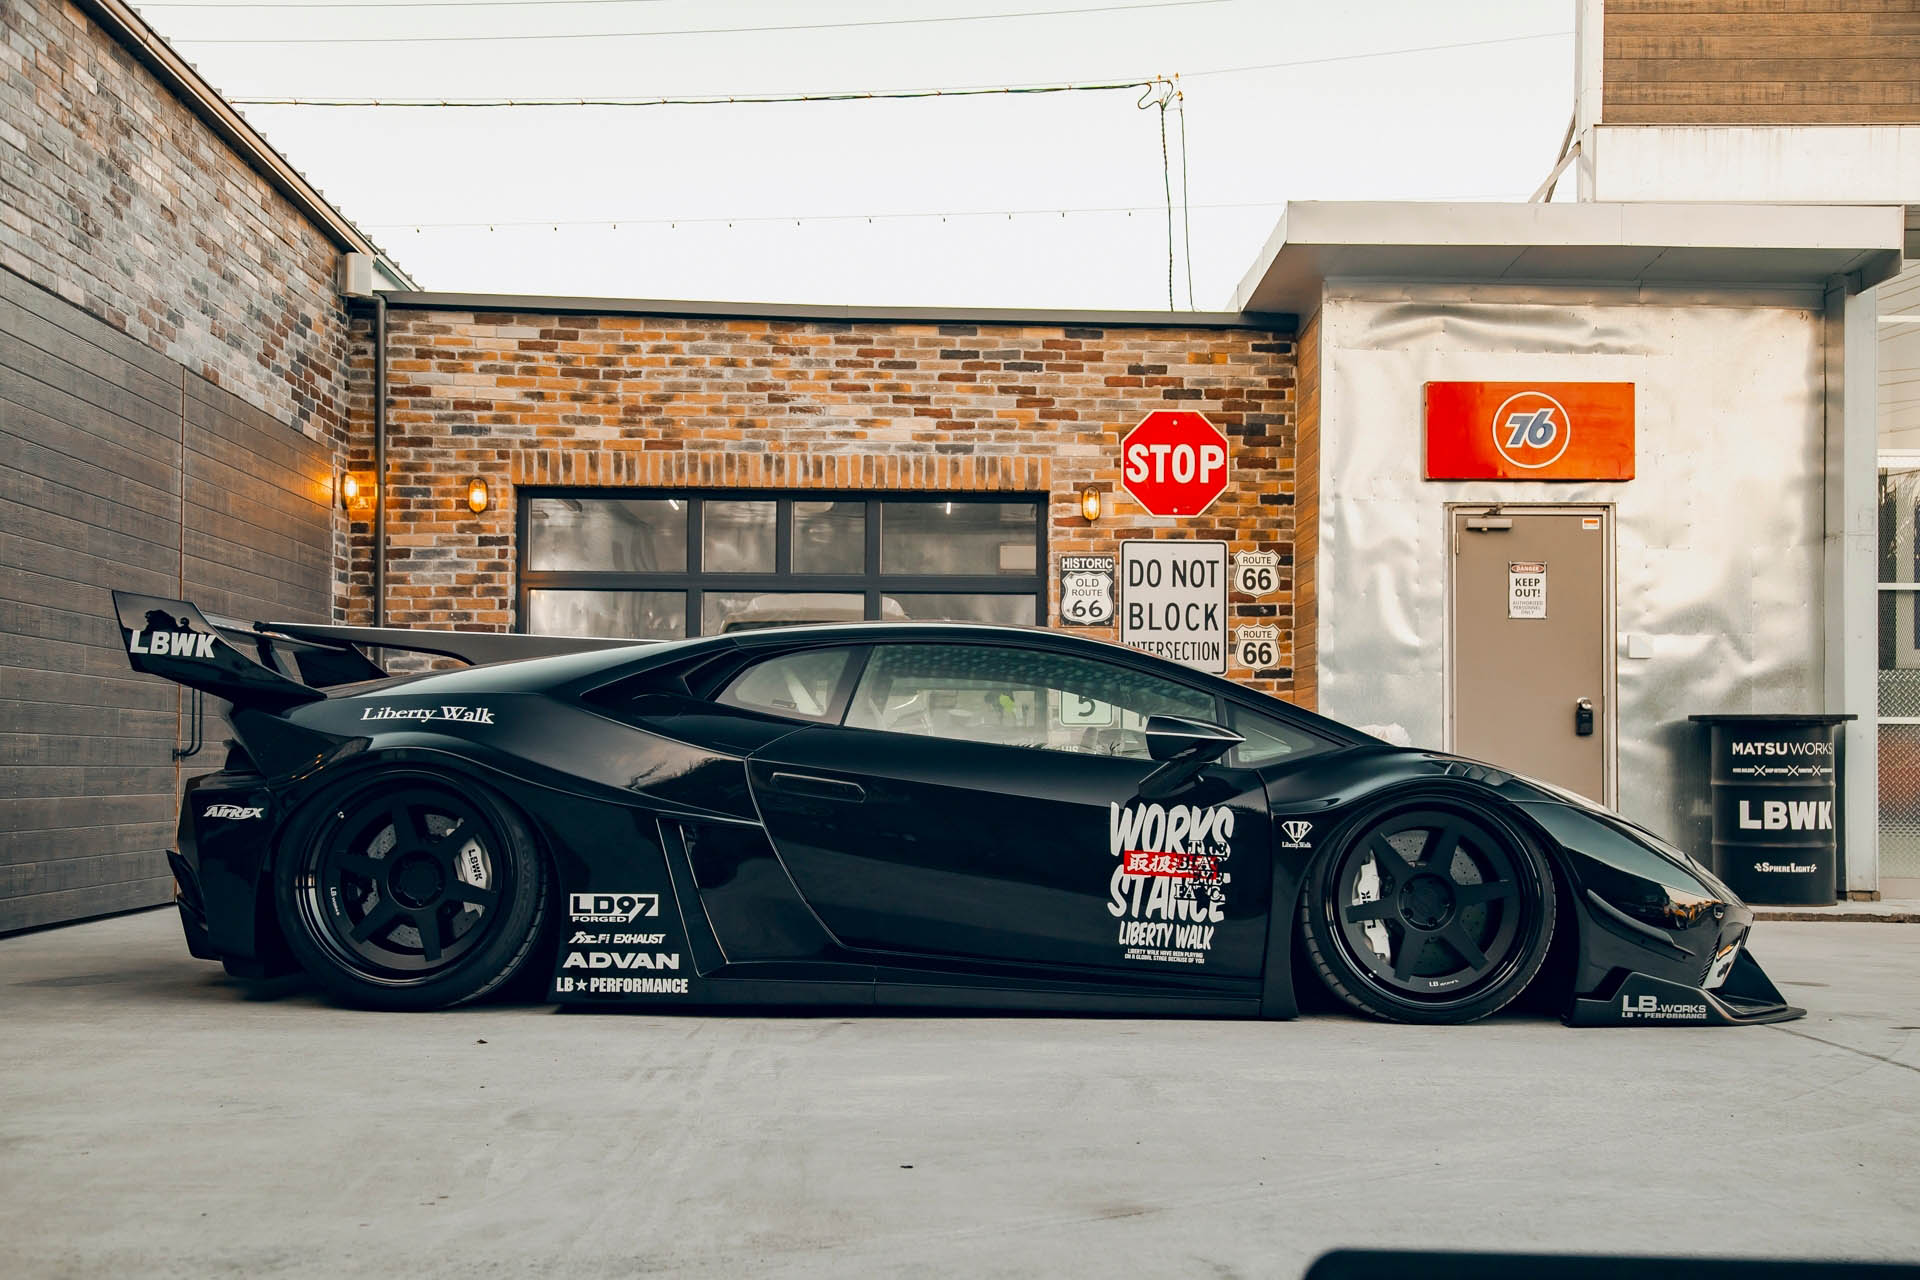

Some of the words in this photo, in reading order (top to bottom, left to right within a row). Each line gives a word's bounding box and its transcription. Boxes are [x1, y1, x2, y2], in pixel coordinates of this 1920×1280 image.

[1505, 408, 1557, 449] 76
[1125, 443, 1225, 484] STOP
[1062, 558, 1113, 569] HISTORIC
[1242, 556, 1272, 565] ROUTE
[1075, 578, 1100, 588] OLD
[1129, 559, 1163, 588] DO
[1172, 559, 1220, 588] NOT
[1242, 568, 1272, 591] 66
[1515, 577, 1541, 587] KEEP
[1071, 589, 1103, 597] ROUTE
[1514, 588, 1541, 598] OUT!
[1072, 599, 1103, 618] 66
[1129, 602, 1219, 632] BLOCK
[130, 629, 218, 659] LBWK
[1243, 630, 1273, 639] ROUTE
[1128, 641, 1220, 661] TERSECTION
[1242, 642, 1273, 665] 66
[360, 706, 438, 723] Liberty
[440, 705, 495, 725] Walk
[1732, 742, 1788, 756] MATSU
[1789, 742, 1832, 756] WORKS
[1739, 800, 1832, 830] LBWK
[1110, 801, 1235, 861] WORKS
[1107, 864, 1231, 923] STANCE
[572, 895, 657, 919] LD97
[597, 933, 611, 944] Fi
[613, 933, 666, 944] EXHAUST
[1118, 920, 1174, 948] LIBERTY
[1176, 924, 1215, 950] WALK
[562, 952, 680, 970] ADVAN
[556, 977, 574, 992] LB
[590, 977, 689, 994] PERFORMANCE
